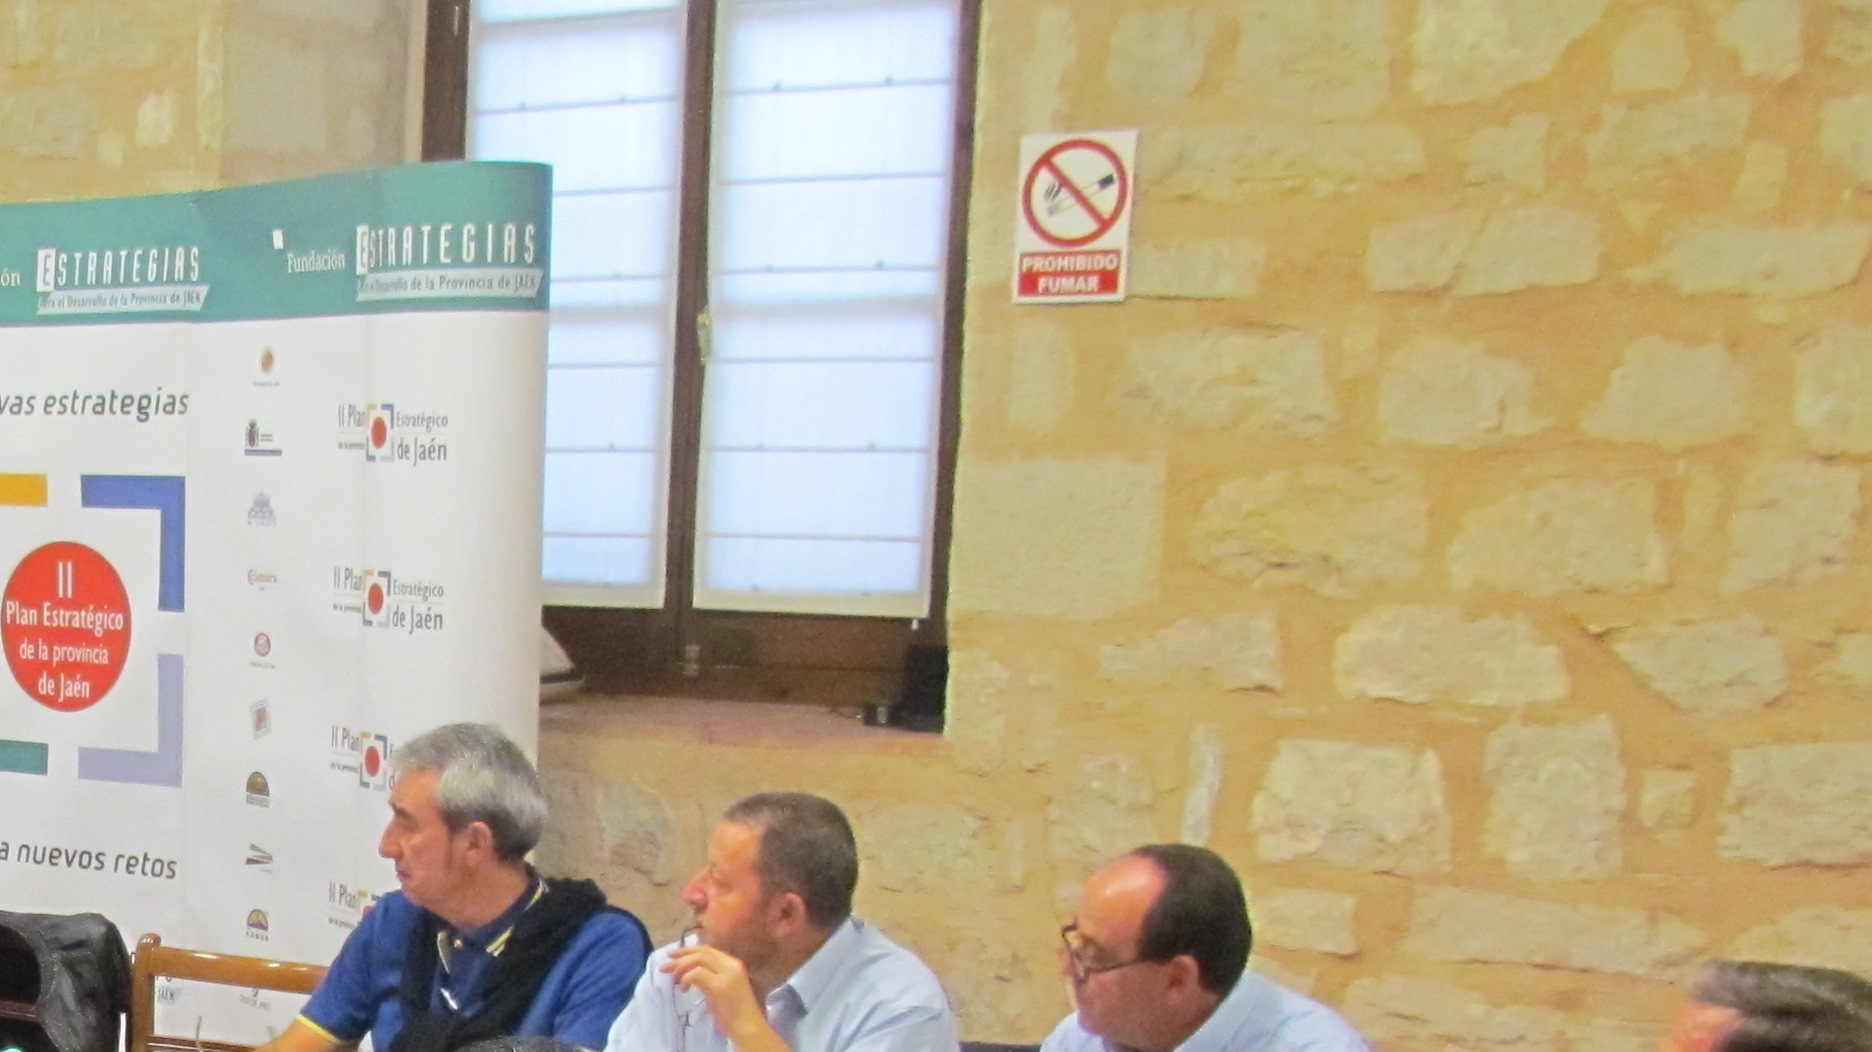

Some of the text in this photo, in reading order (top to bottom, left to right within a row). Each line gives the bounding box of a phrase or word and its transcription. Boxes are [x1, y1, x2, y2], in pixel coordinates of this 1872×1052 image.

[287, 223, 536, 273] Fundación ESTRATEGIAS
[1022, 253, 1119, 273] PROHIBIDO
[38, 246, 199, 290] ESTRATEGIAS
[130, 292, 168, 306] Provincia
[1038, 276, 1101, 294] FUMAR
[43, 386, 190, 423] estrategias
[348, 404, 366, 427] Plan
[396, 411, 449, 433] Estratégico
[397, 436, 447, 468] de Jaén
[344, 567, 365, 591] Plan
[392, 579, 445, 602] Estratégico
[6, 600, 124, 638] Plan Estratégico
[392, 604, 443, 635] de Jaén
[19, 637, 109, 668] de la provincia
[38, 671, 90, 703] de Jaén
[341, 727, 361, 752] Plan
[17, 843, 106, 872] nuevos
[114, 851, 178, 879] retos
[339, 884, 360, 909] Plan
